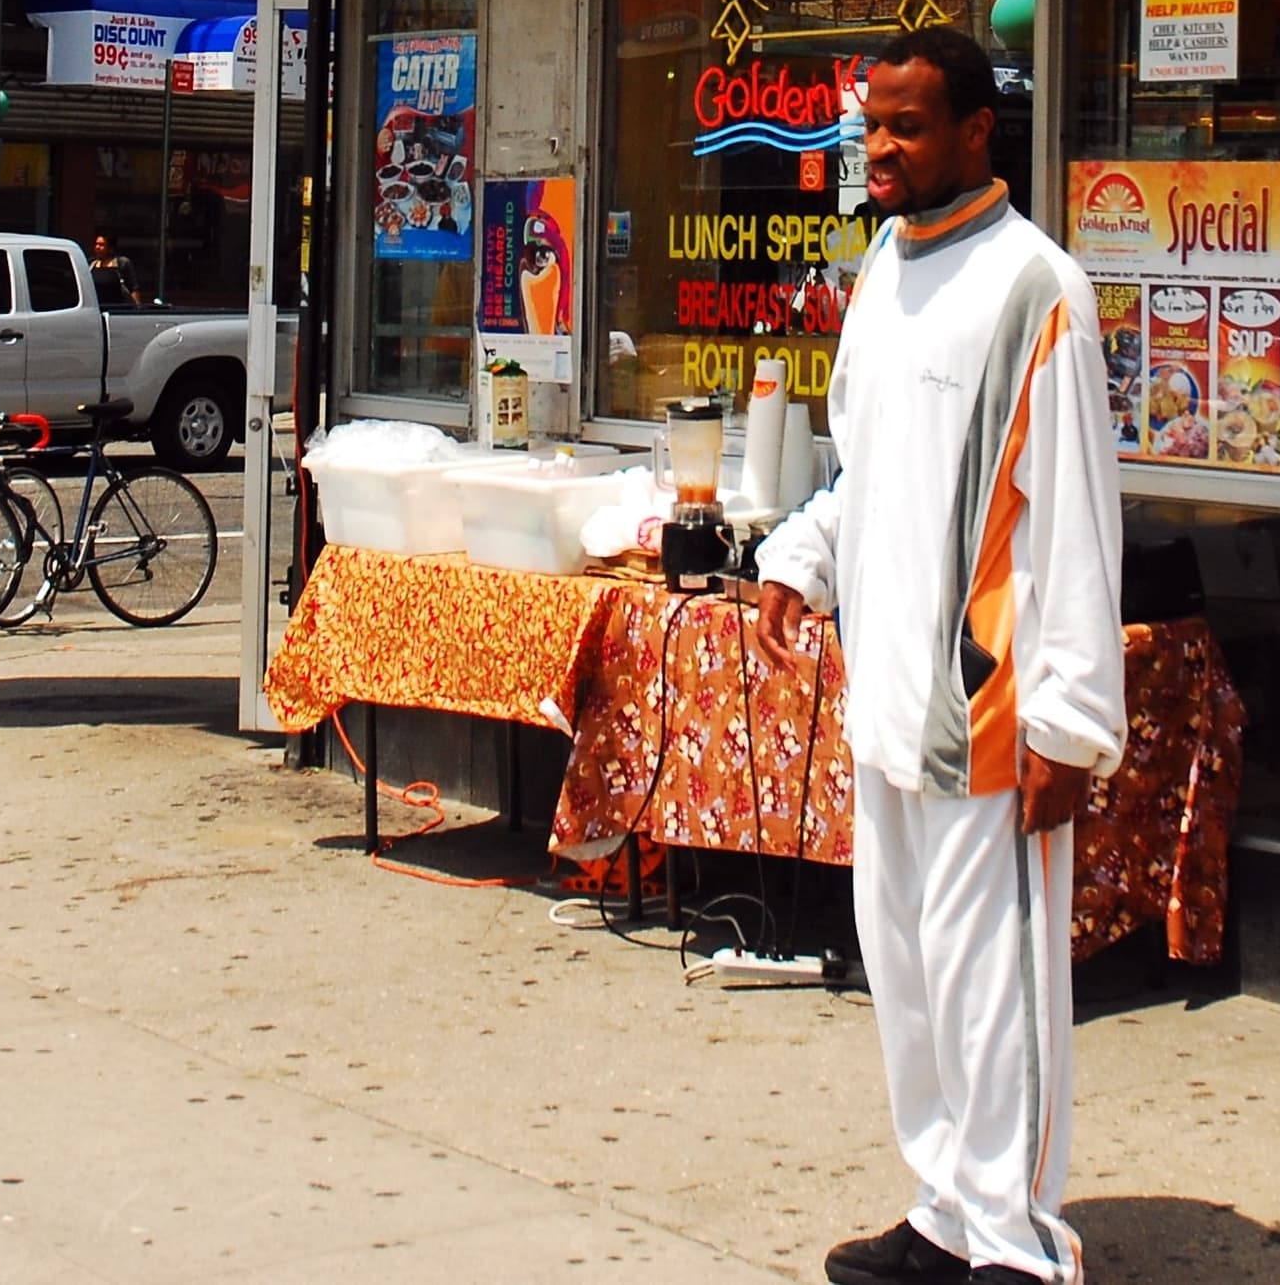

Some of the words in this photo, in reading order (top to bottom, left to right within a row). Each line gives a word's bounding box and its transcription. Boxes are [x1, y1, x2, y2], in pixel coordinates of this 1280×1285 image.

[1146, 4, 1178, 18] HELP
[1181, 1, 1235, 15] WANTED
[94, 24, 167, 47] DISCOUNT
[1149, 39, 1173, 50] HELP
[1183, 36, 1229, 49] CASHIERS
[1183, 22, 1225, 34] KITCHEN
[1169, 51, 1208, 61] WANTED
[392, 54, 460, 92] CATER
[417, 86, 444, 116] big
[694, 63, 833, 128] Golden
[668, 214, 758, 260] LUNCH
[1167, 186, 1269, 265] Special
[678, 281, 795, 330] BREAKFAST
[1228, 329, 1271, 358] SOUP
[683, 342, 743, 390] ROTI
[755, 345, 831, 396] OLD
